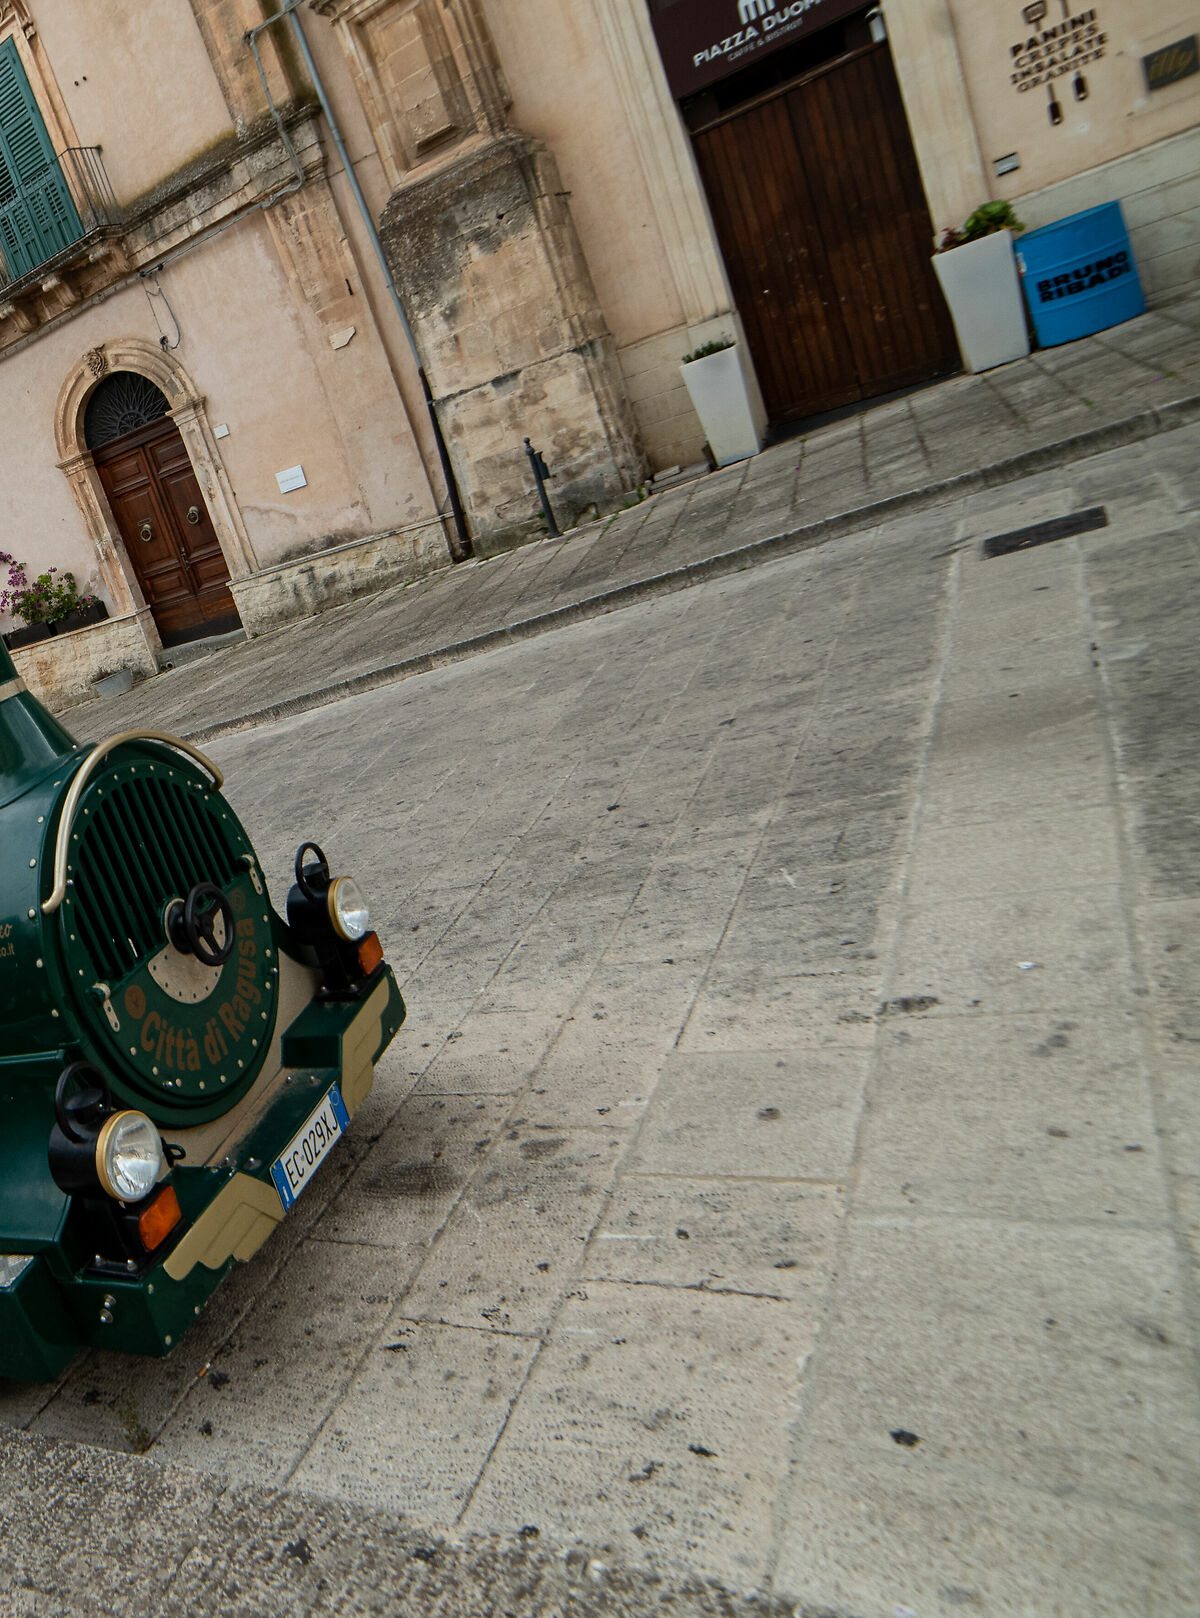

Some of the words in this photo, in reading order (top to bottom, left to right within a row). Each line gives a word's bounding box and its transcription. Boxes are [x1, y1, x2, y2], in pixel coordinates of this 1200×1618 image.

[693, 26, 759, 67] PIAZZA
[1010, 9, 1097, 57] PANINI
[1010, 32, 1109, 85] INSALATE
[1016, 47, 1107, 93] GRANITE
[1038, 251, 1128, 292] BRUNO
[141, 1011, 200, 1072] Città
[204, 1017, 228, 1065] di
[218, 918, 261, 1042] Ragusa
